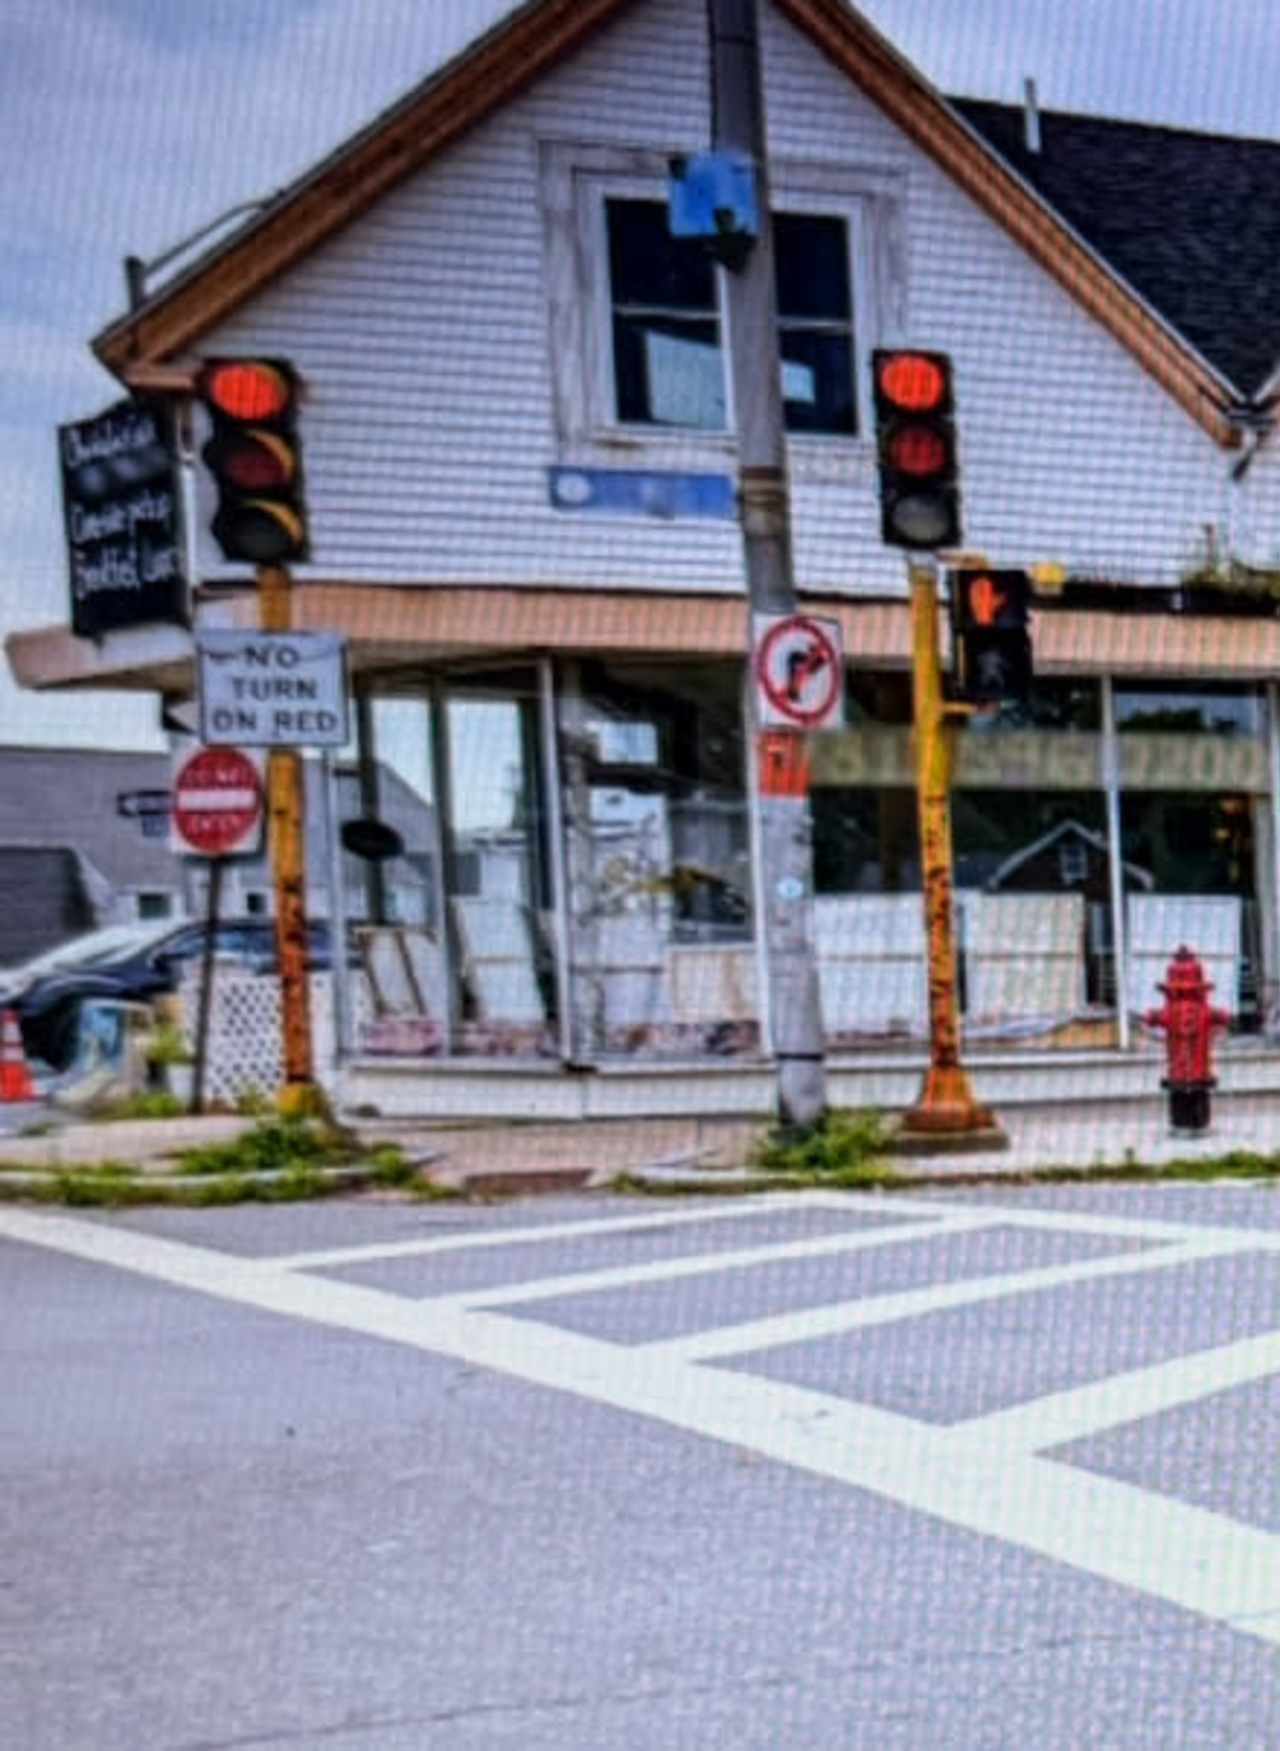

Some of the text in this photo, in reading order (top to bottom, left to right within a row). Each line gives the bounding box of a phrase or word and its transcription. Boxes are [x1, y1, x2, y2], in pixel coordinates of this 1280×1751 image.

[245, 645, 299, 668] NO
[232, 676, 317, 700] TURN
[212, 709, 337, 734] ON RED
